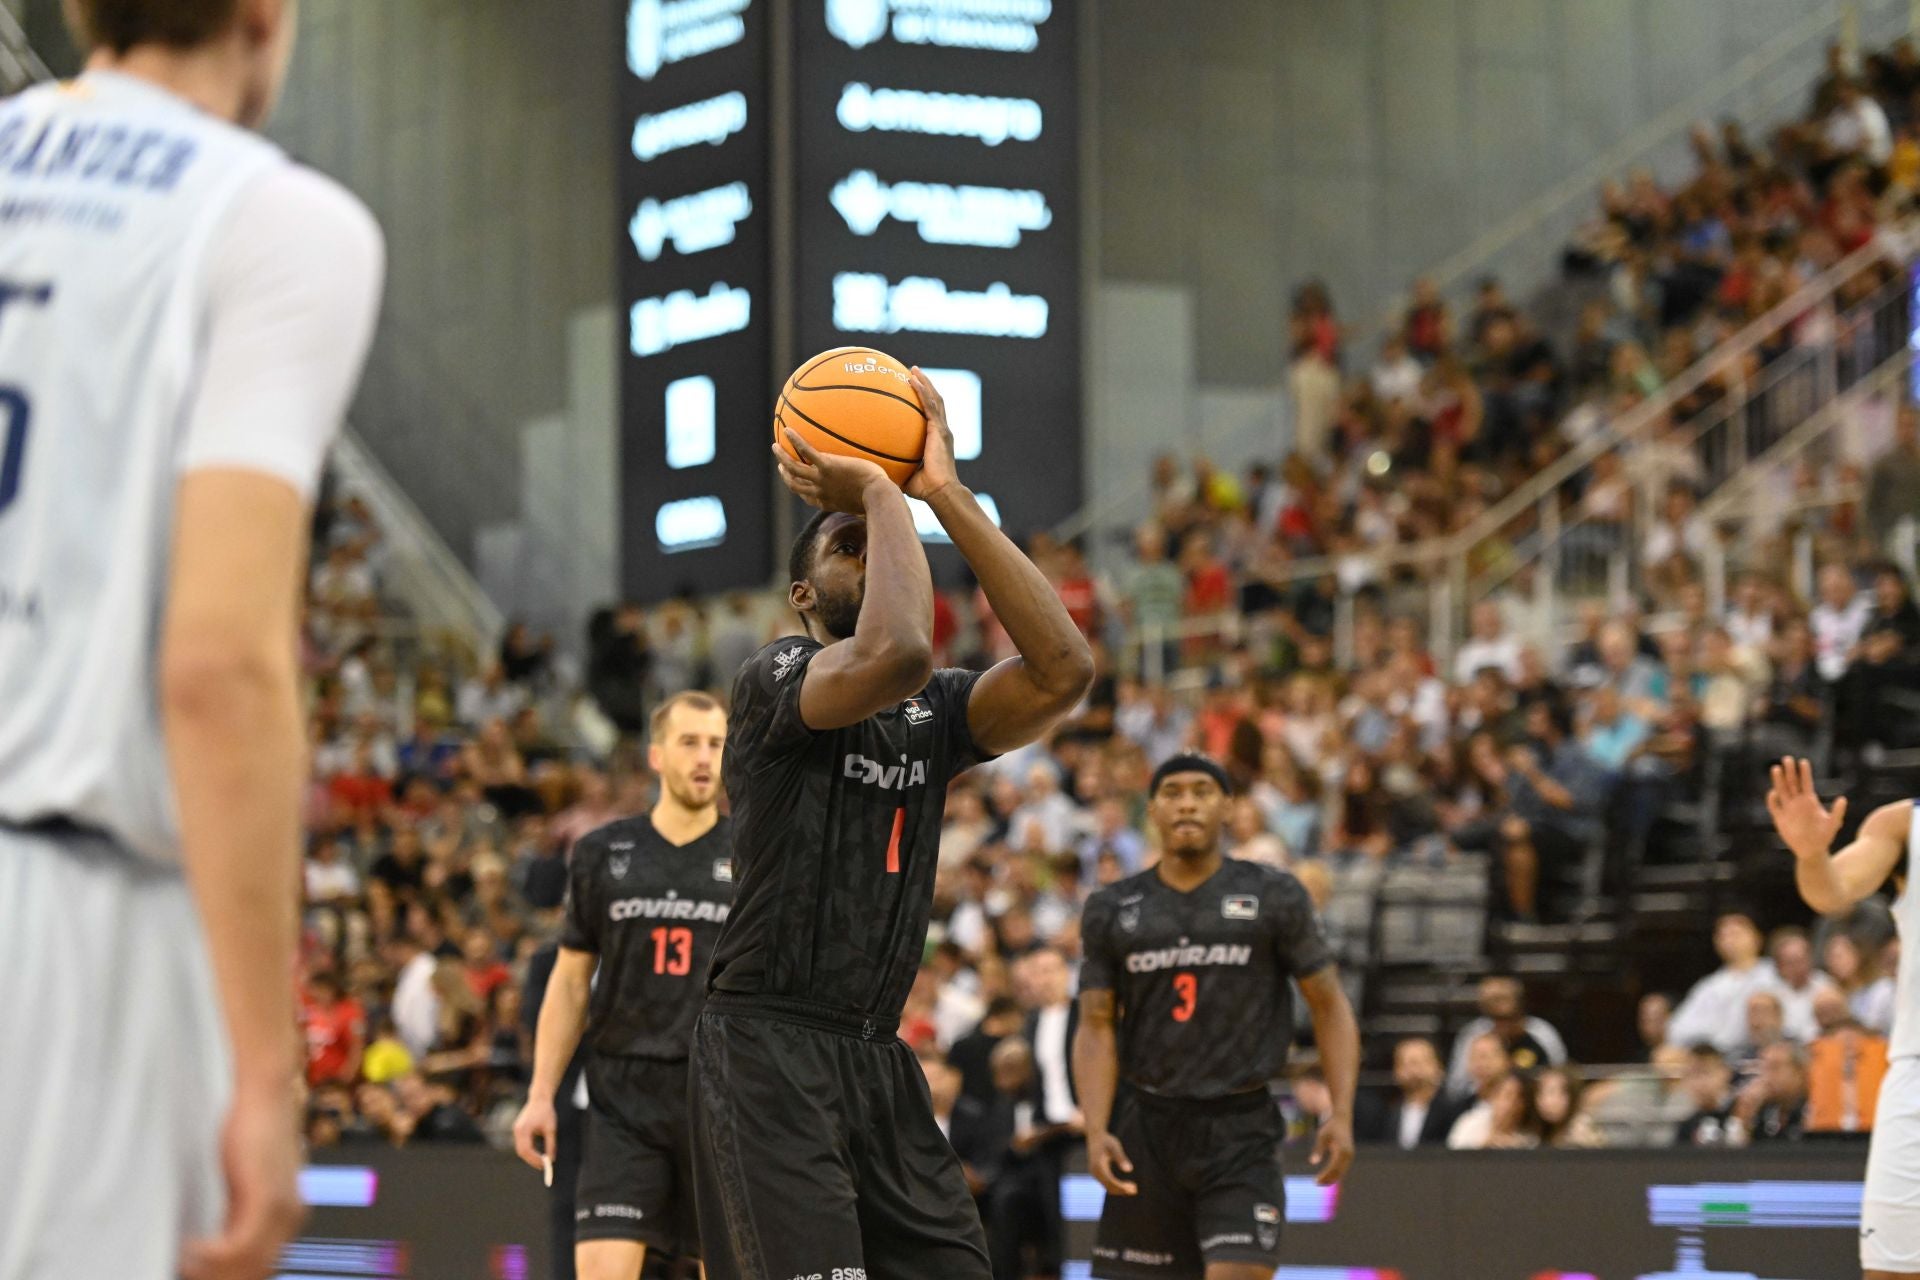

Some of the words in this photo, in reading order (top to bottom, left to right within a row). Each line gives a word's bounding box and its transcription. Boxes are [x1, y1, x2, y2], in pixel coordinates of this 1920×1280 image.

[886, 807, 905, 873] 1
[650, 926, 693, 976] 13
[1171, 971, 1198, 1022] 3
